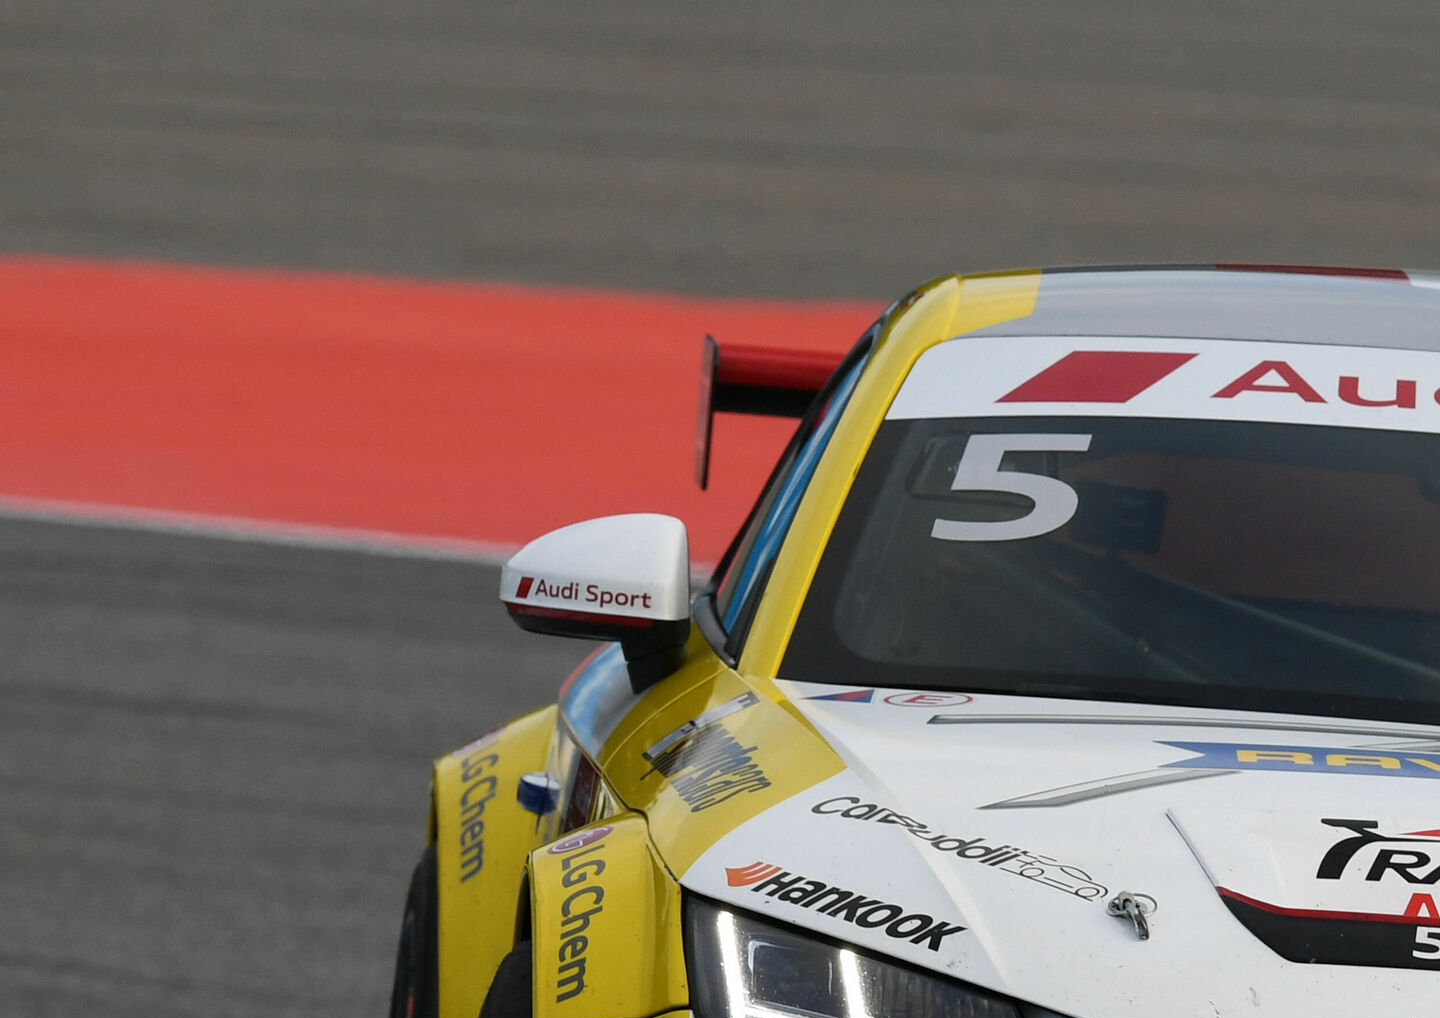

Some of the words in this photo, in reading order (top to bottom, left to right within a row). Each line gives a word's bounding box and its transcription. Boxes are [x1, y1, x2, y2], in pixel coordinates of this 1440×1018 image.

[931, 434, 1093, 541] 5
[535, 579, 579, 600] Audi
[585, 585, 652, 608] Sport
[460, 776, 498, 883] Chem
[562, 844, 606, 889] LG
[556, 886, 605, 1004] Chem
[750, 871, 968, 951] Hankook
